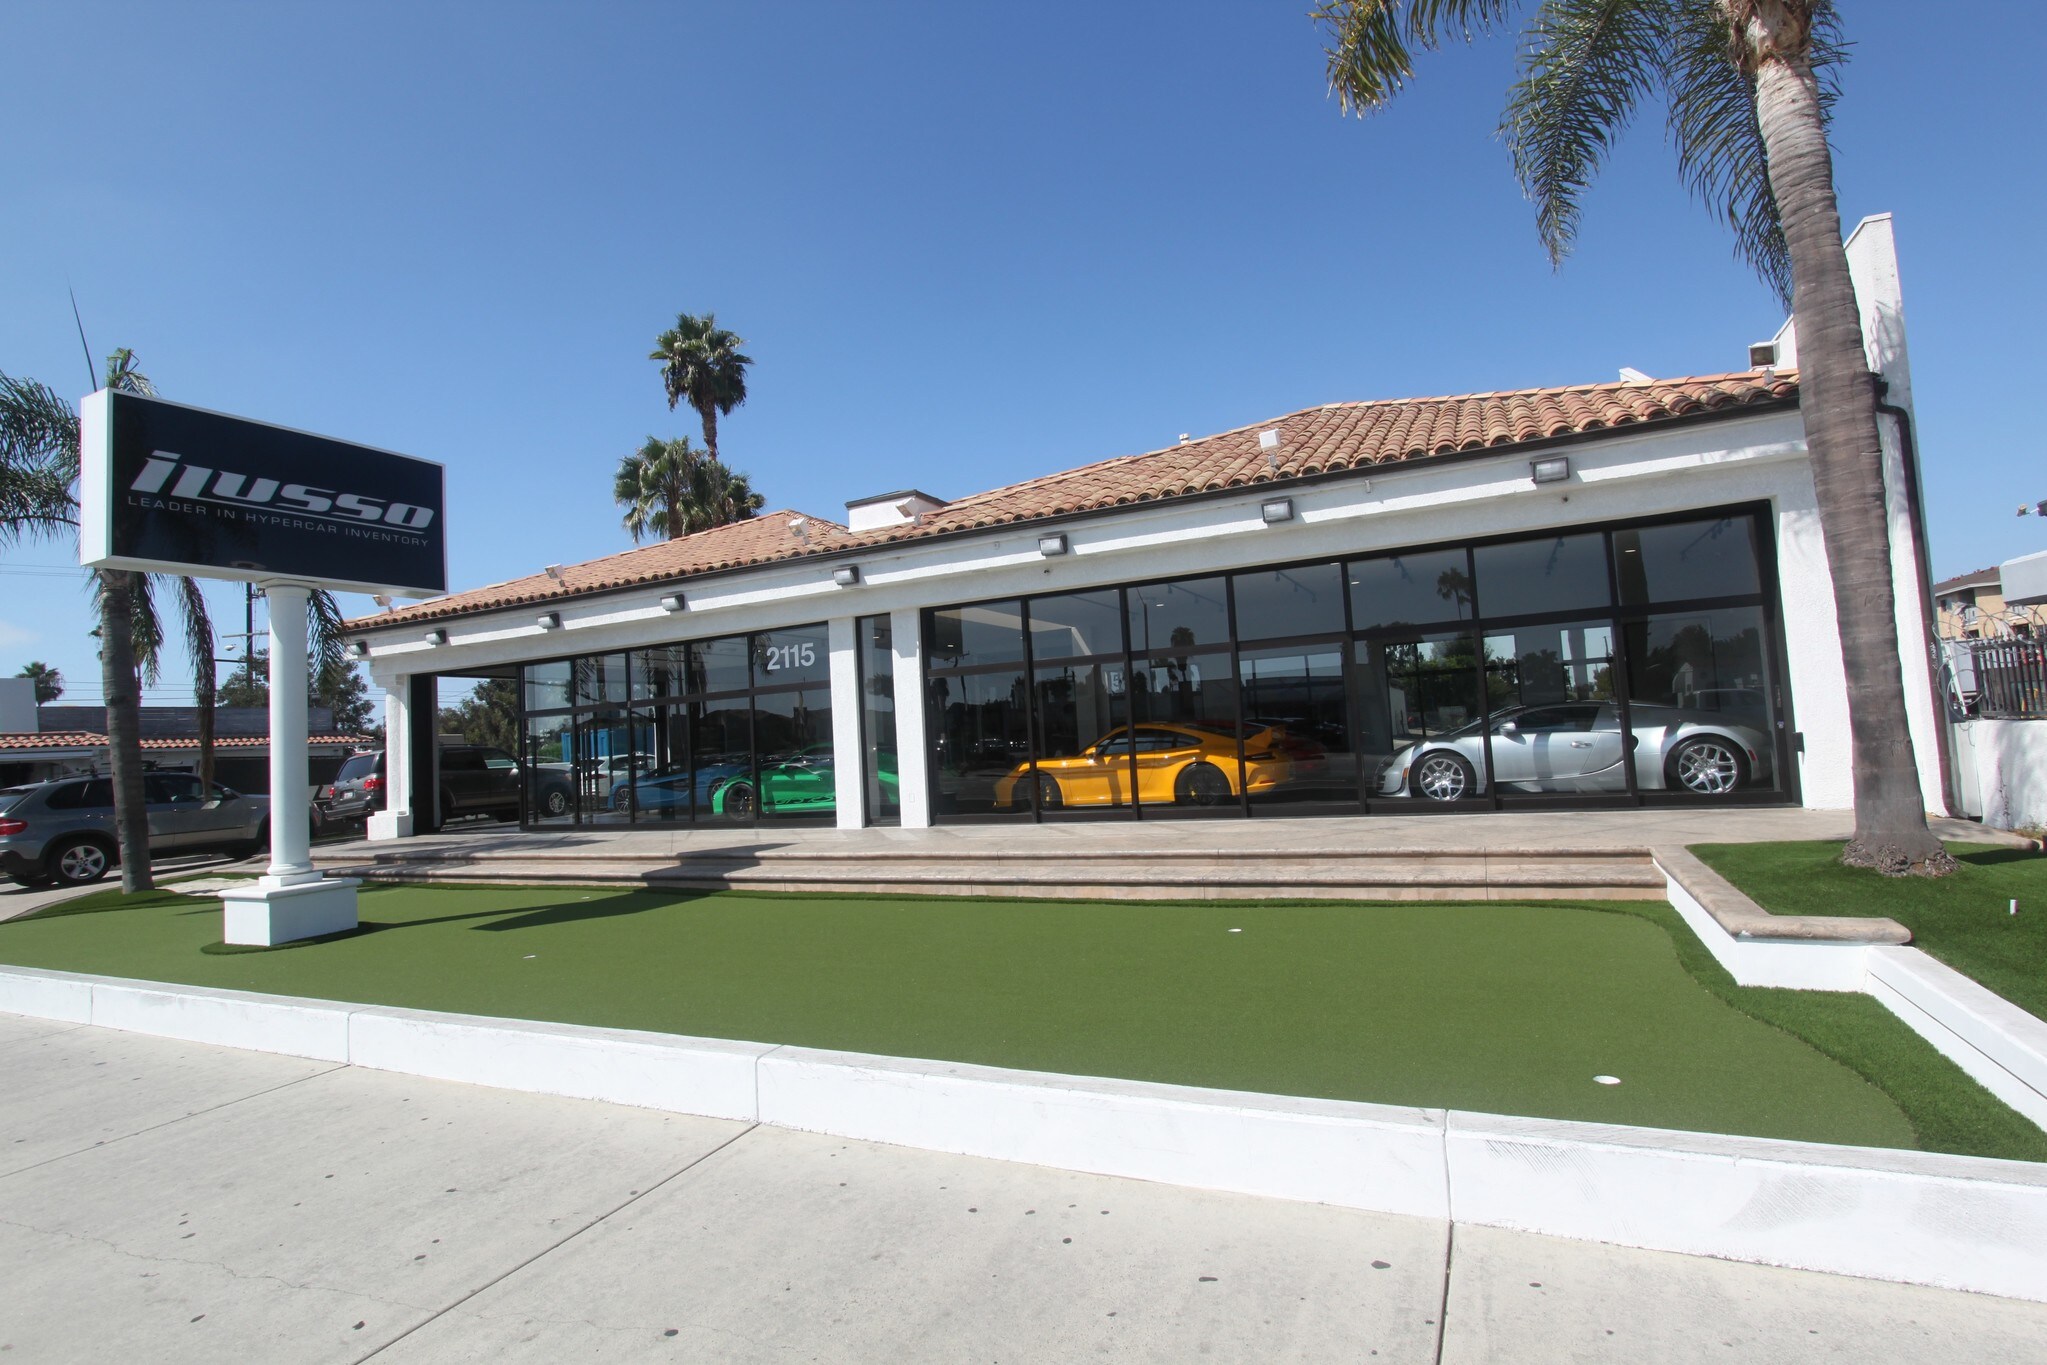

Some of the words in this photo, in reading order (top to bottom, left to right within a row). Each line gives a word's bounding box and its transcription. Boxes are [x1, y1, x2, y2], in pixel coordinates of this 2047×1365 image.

[128, 495, 207, 515] LEADER
[217, 508, 236, 519] IN
[245, 513, 337, 533] HYPERCAR
[345, 528, 429, 547] INVENTORY
[766, 642, 815, 670] 2115
